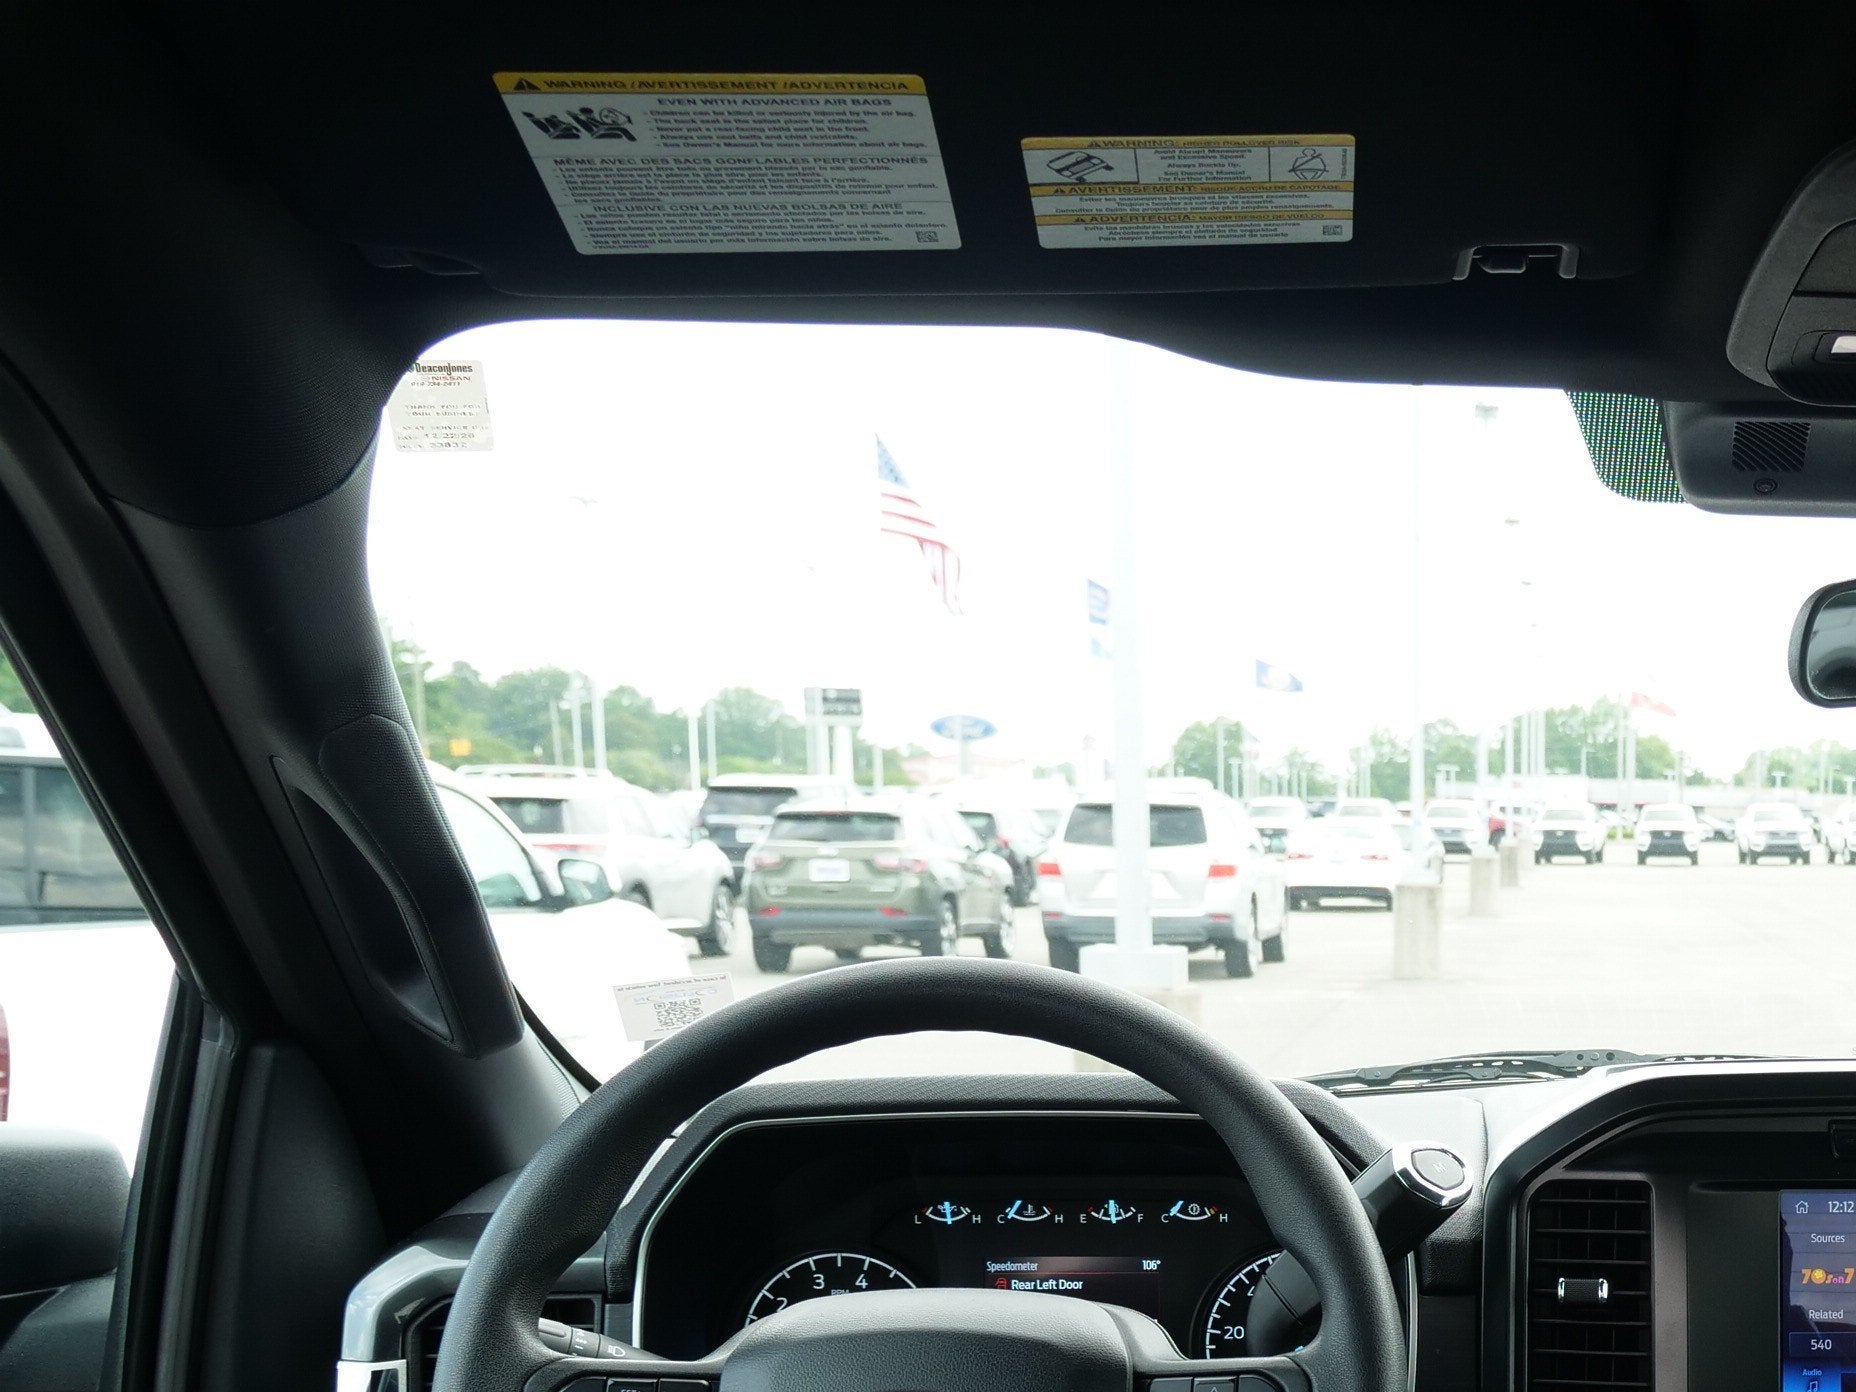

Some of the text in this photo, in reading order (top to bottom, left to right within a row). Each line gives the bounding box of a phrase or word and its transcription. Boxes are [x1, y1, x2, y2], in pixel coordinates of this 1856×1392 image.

[543, 80, 626, 90] WARNING
[657, 98, 893, 106] EVEN WITH ADVANCED AIR BAGS
[600, 158, 637, 166] AVEC
[640, 158, 670, 166] DES
[672, 158, 712, 166] SACS
[715, 158, 811, 166] GONFLABLES
[593, 205, 665, 213] INCLUSIVE
[733, 204, 788, 212] NUEVAS
[1828, 1201, 1855, 1213] 12:12
[914, 1214, 981, 1223] L H
[997, 1214, 1063, 1224] C H
[1081, 1214, 1143, 1224] E F
[1161, 1214, 1228, 1223] C H
[1811, 1233, 1846, 1243] Sources
[986, 1260, 1039, 1273] Speedometer
[1142, 1260, 1161, 1271] 106°
[813, 1274, 825, 1289] 3
[855, 1274, 869, 1289] 4
[1011, 1279, 1083, 1290] Rear Left Door
[1809, 1309, 1844, 1319] Related
[1223, 1326, 1245, 1340] 20
[1810, 1339, 1832, 1350] 540
